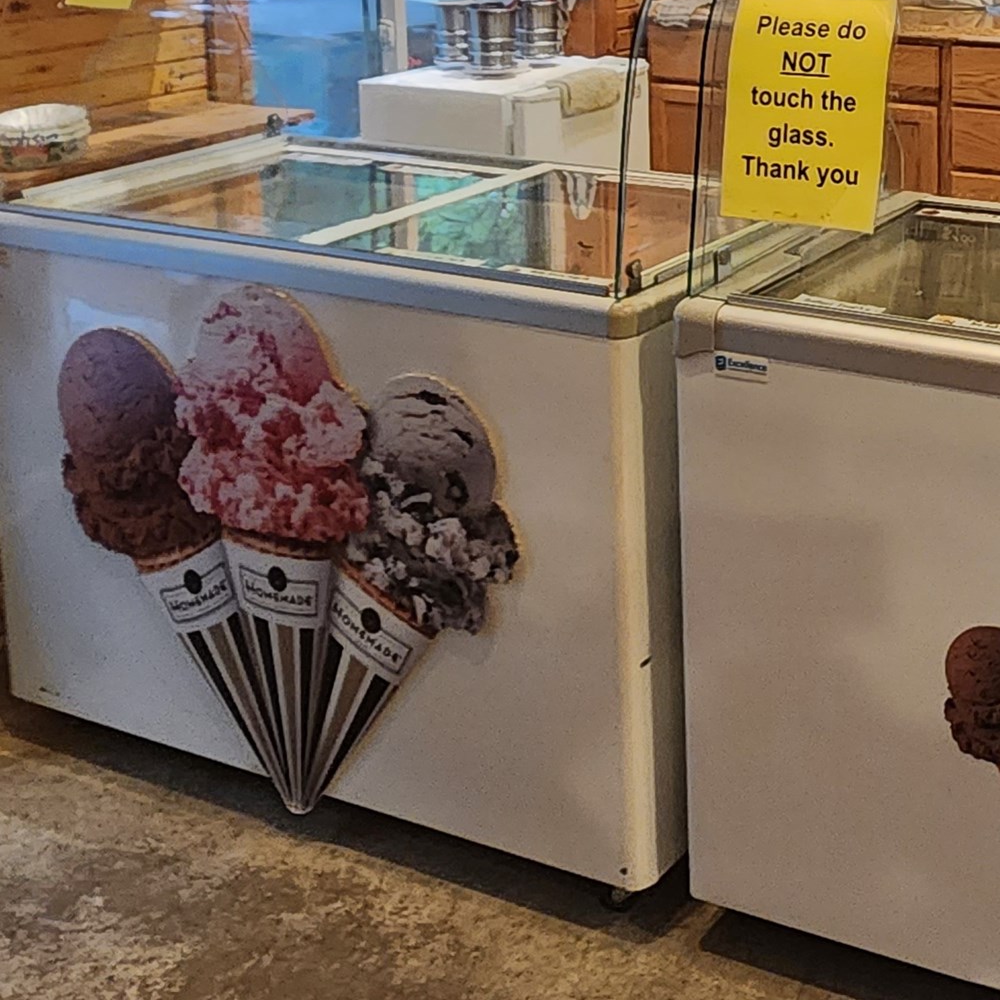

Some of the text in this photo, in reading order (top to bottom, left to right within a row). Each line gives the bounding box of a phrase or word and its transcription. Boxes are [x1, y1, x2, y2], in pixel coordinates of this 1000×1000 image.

[757, 15, 866, 40] Please do
[780, 50, 832, 75] NOT
[751, 86, 856, 112] touch the
[768, 123, 834, 148] glass.
[741, 155, 859, 188] Thank you
[168, 579, 228, 612] HOMEMADE
[243, 578, 313, 608] HOMEMADE
[331, 601, 402, 664] HOMEMADE
